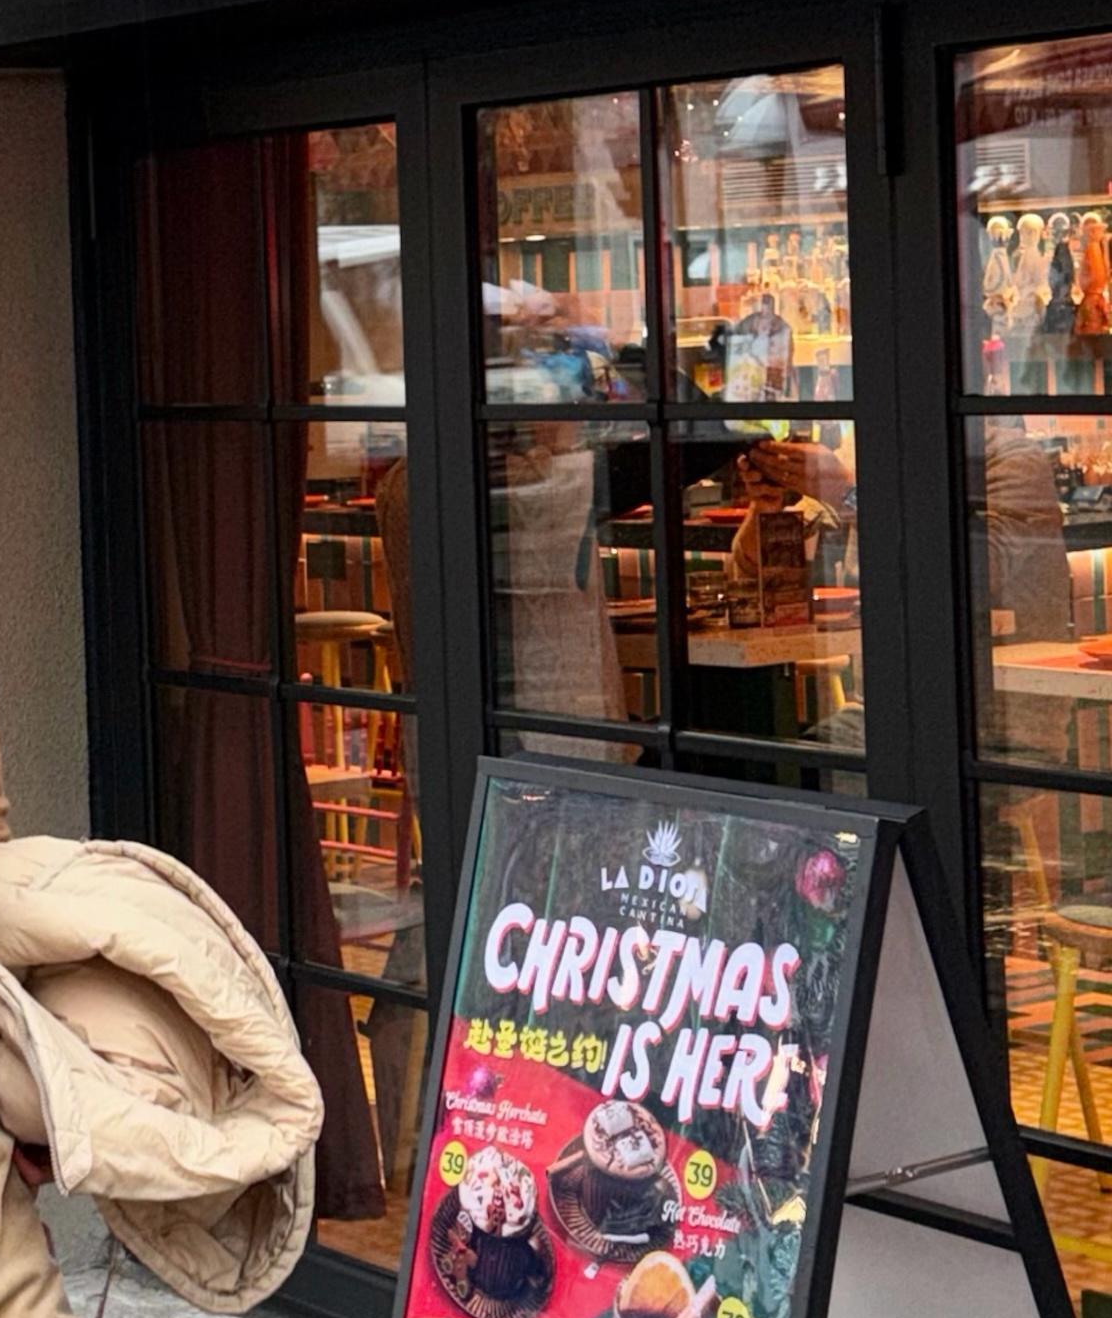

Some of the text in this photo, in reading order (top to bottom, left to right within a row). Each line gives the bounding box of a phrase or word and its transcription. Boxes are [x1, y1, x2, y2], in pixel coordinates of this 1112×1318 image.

[600, 865, 630, 891] LA
[619, 905, 685, 929] CANTINA
[484, 902, 802, 1032] CHRISTMAS
[601, 1021, 800, 1131] IS HERE
[445, 1090, 496, 1116] Christmas
[442, 1151, 465, 1175] 39
[687, 1162, 714, 1187] 39
[661, 1200, 741, 1234] Hot Chocolate
